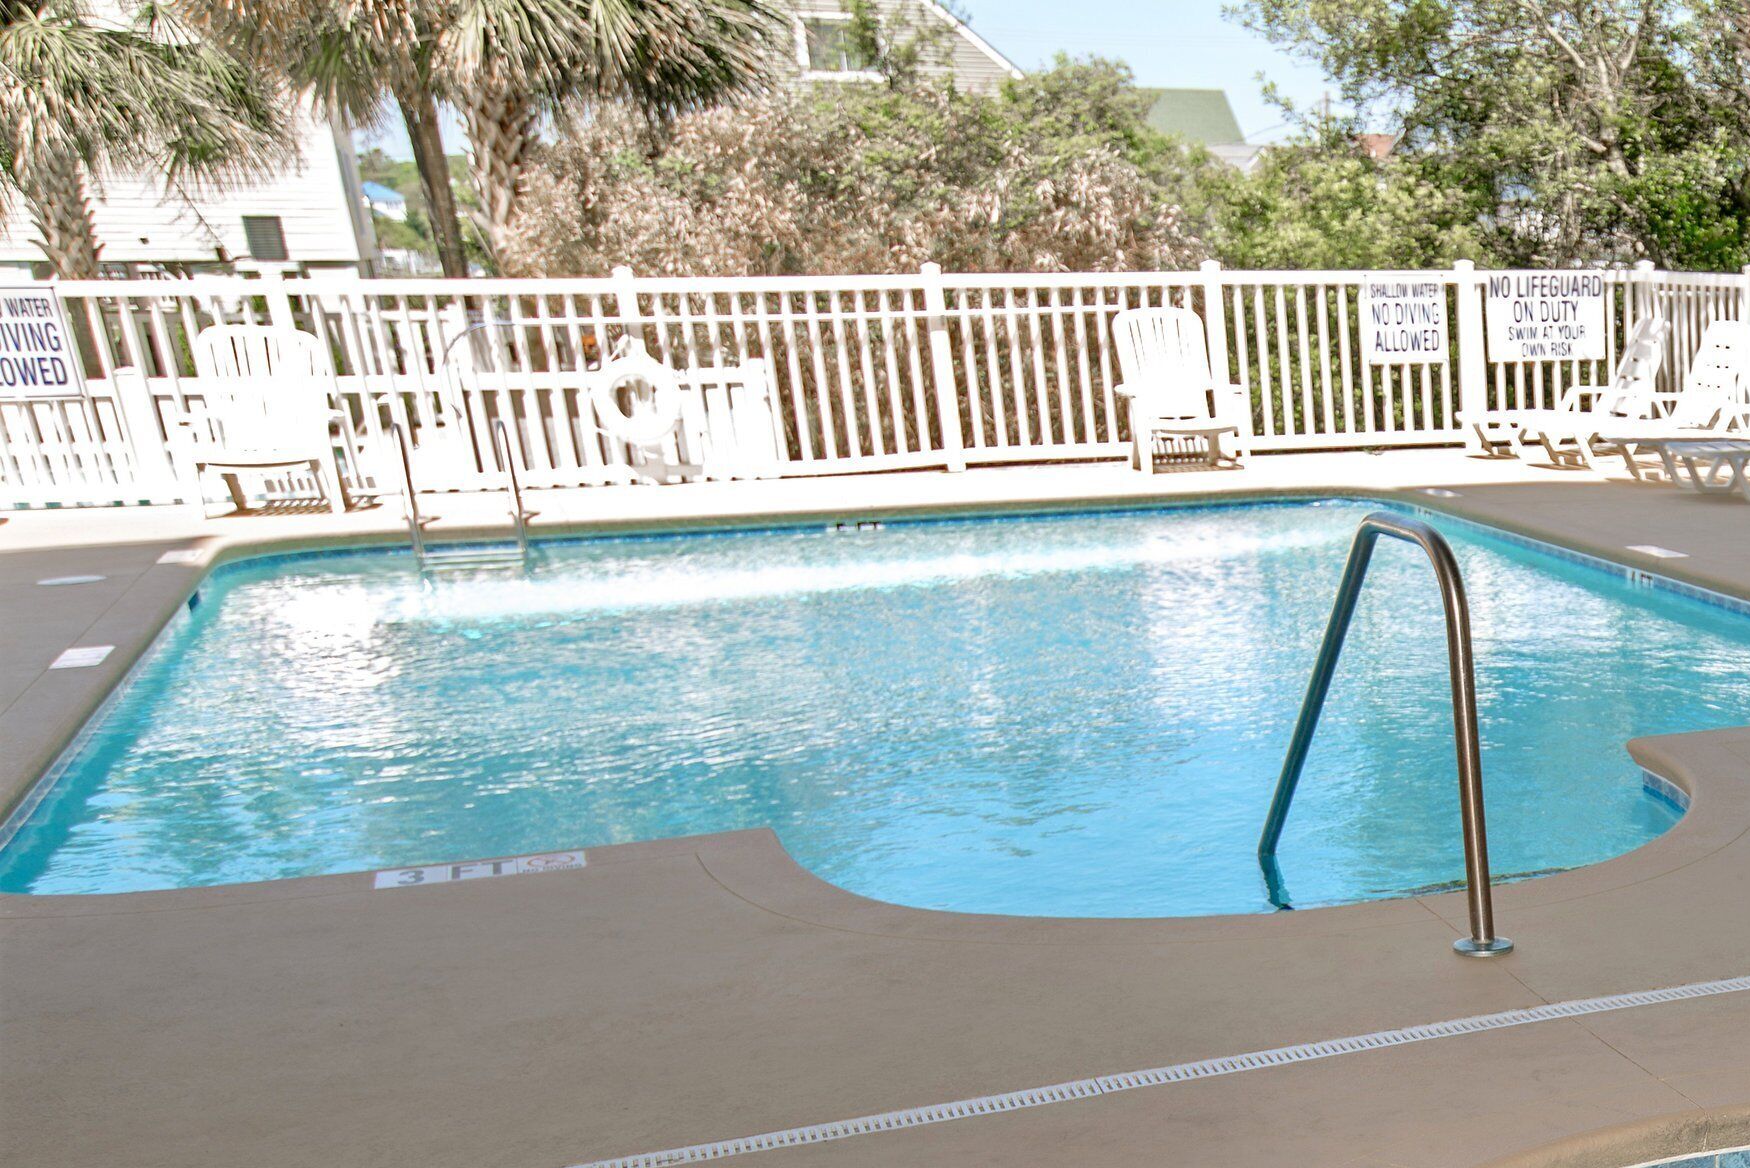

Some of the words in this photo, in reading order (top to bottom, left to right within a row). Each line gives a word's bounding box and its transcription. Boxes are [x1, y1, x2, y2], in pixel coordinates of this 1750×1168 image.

[1370, 283, 1408, 298] SHALLOW
[1412, 283, 1439, 298] WATER
[1489, 275, 1511, 298] NO
[1517, 275, 1602, 298] LIFEGUARD
[4, 298, 53, 317] WATER
[1372, 303, 1390, 325] NO
[1396, 302, 1440, 325] DIVING
[1513, 300, 1533, 322] ON
[1540, 300, 1578, 322] DUTY
[0, 322, 62, 352] IVING
[1375, 330, 1440, 352] ALLOWED
[1508, 326, 1537, 340] SWIM
[1543, 325, 1554, 339] AT
[1558, 325, 1585, 339] YOUR
[1522, 343, 1546, 357] OWN
[1551, 343, 1573, 356] RISK
[0, 357, 68, 386] OWED
[398, 870, 424, 885] 3
[451, 859, 513, 881] FT
